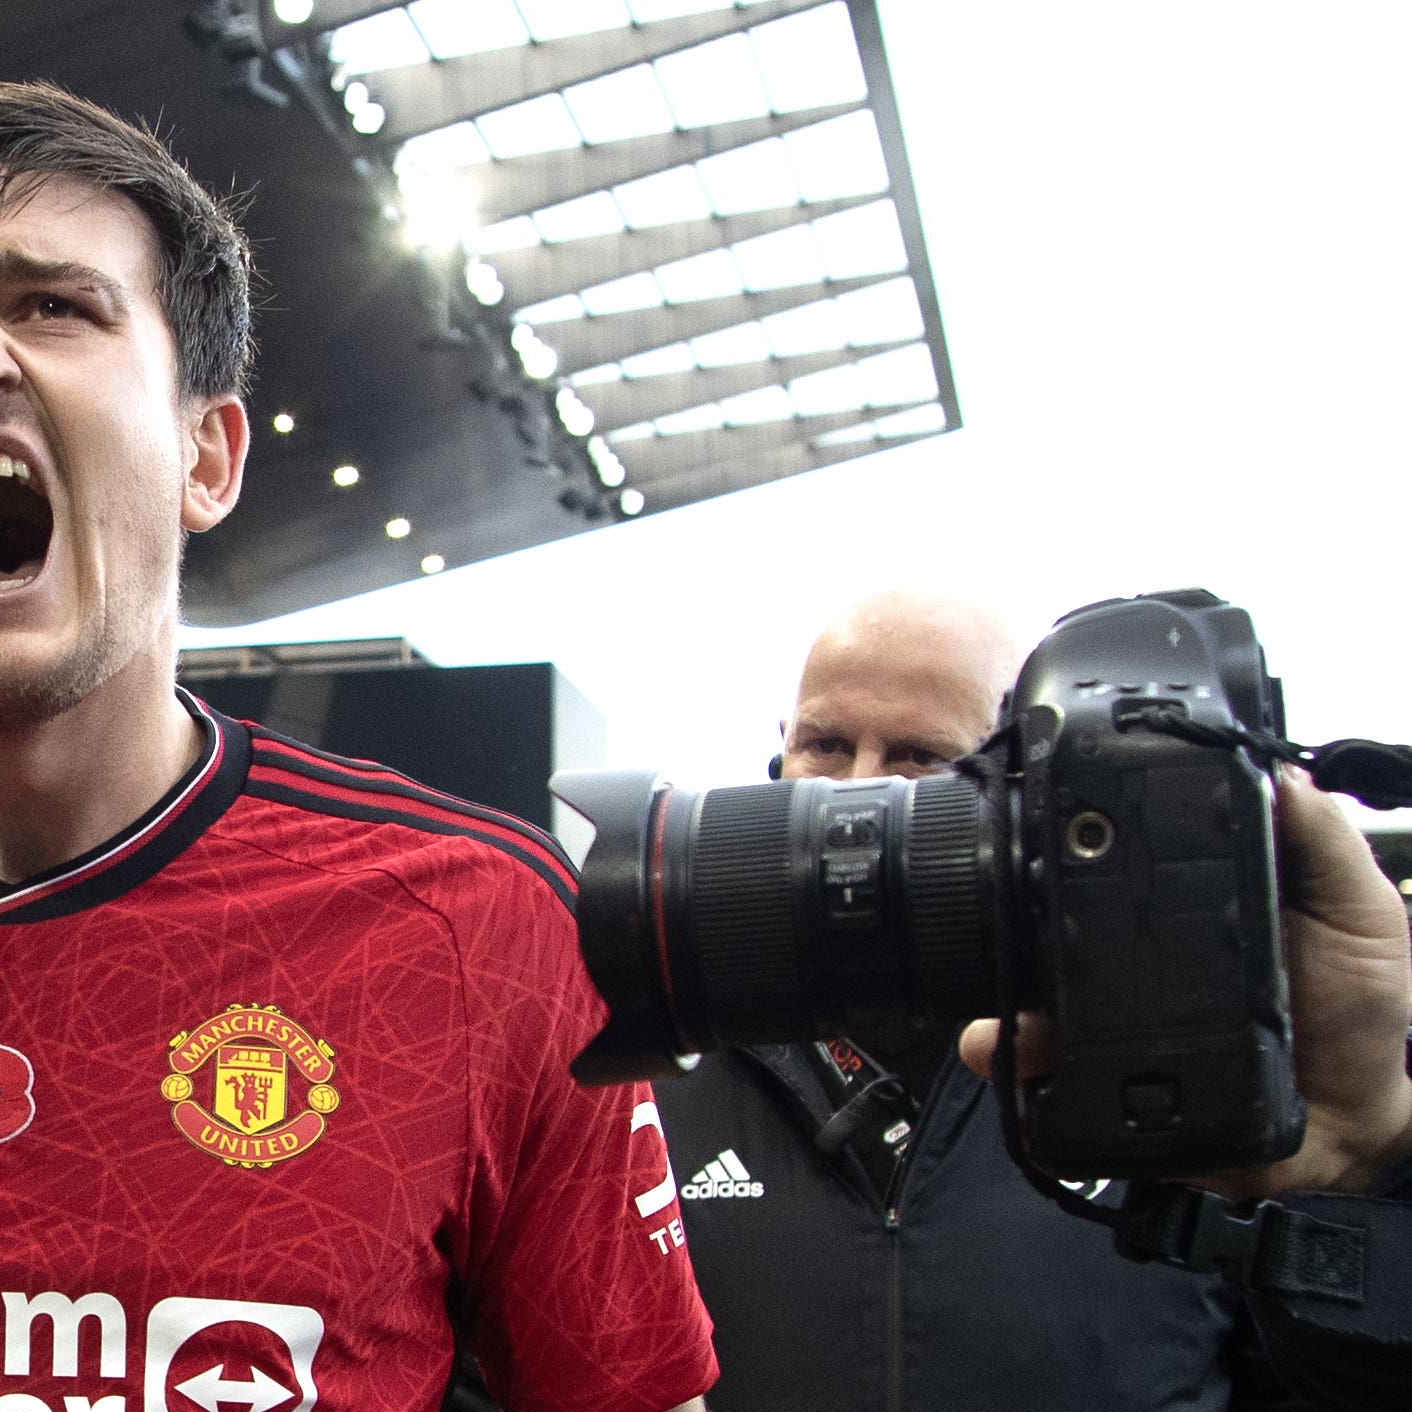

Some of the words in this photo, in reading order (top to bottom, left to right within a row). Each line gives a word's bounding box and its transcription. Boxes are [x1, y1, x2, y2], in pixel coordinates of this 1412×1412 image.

[180, 1015, 322, 1074] MANCHESTER
[200, 1125, 300, 1158] UNITED
[680, 1180, 765, 1200] adidas
